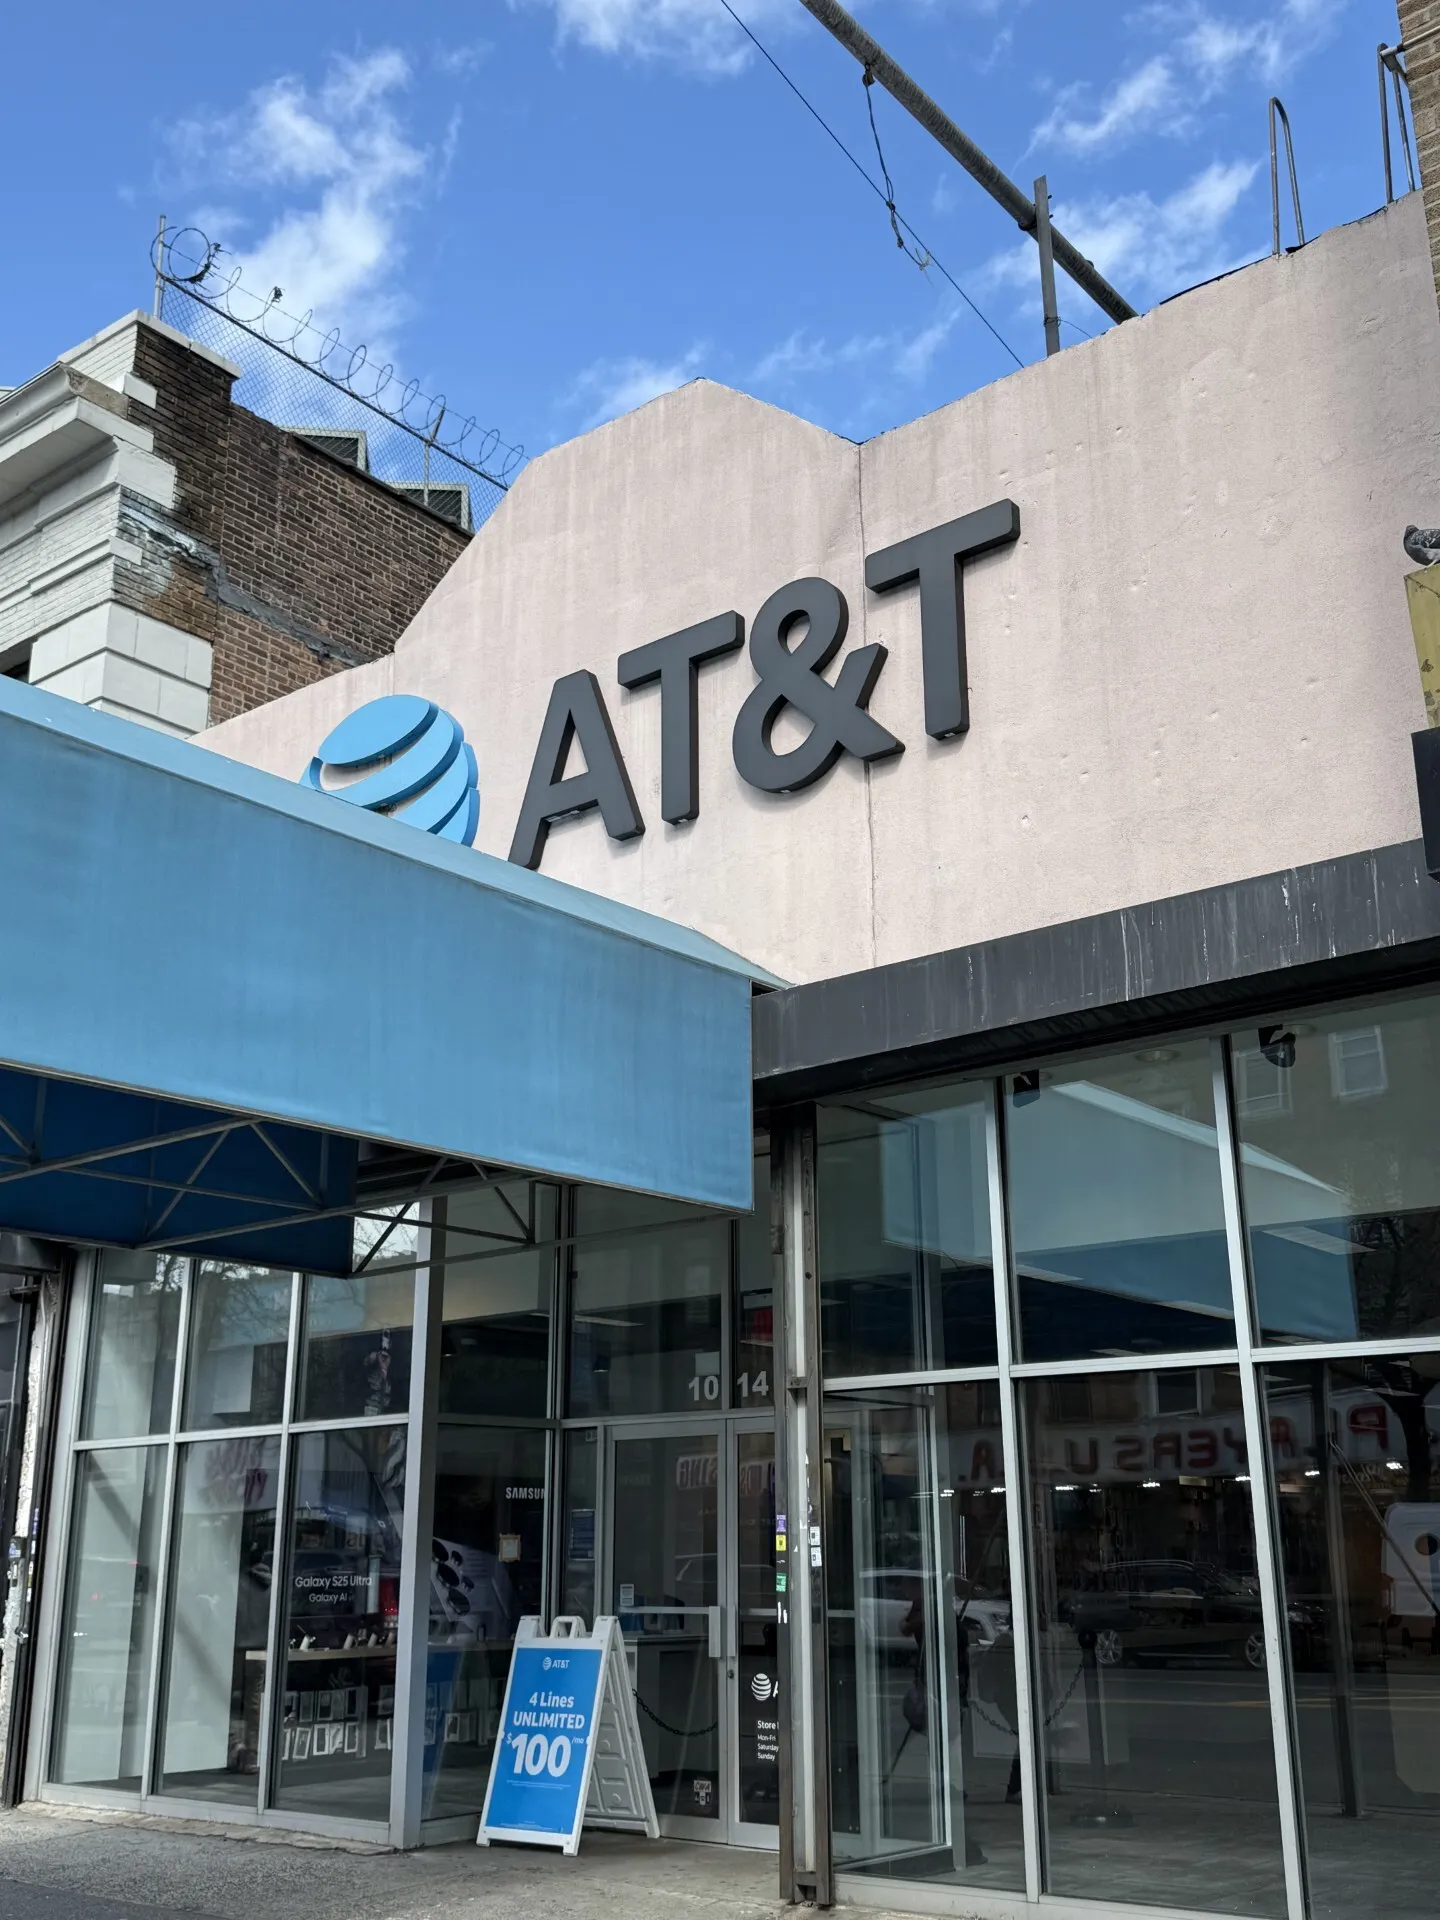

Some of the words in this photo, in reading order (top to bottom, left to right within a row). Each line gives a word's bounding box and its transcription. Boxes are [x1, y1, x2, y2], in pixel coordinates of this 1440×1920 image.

[509, 499, 1021, 869] AT&T
[295, 1576, 330, 1589] Galaxy
[332, 1575, 348, 1587] S25
[350, 1575, 372, 1587] Ultra
[308, 1593, 338, 1604] Galaxy
[553, 1659, 570, 1669] AT&T
[529, 1692, 538, 1706] 4
[540, 1691, 574, 1709] Lines
[513, 1711, 585, 1730] UNLIMITED
[757, 1719, 776, 1730] Store
[757, 1734, 776, 1742] Mon-Fri
[757, 1743, 779, 1753] Saturday
[757, 1752, 776, 1762] Sunday
